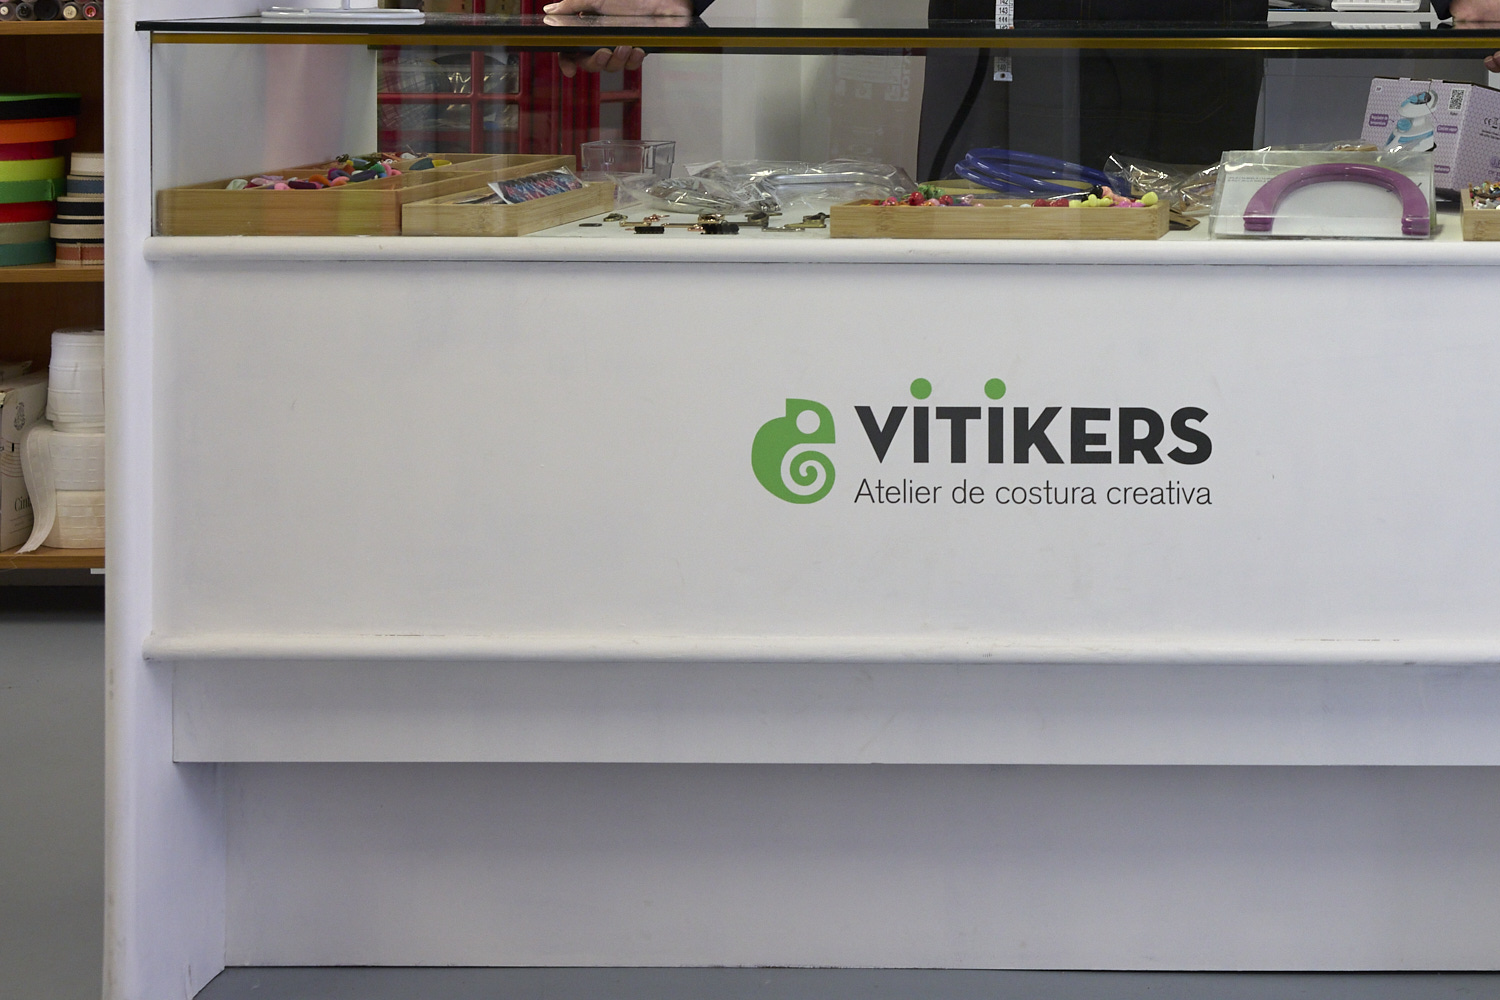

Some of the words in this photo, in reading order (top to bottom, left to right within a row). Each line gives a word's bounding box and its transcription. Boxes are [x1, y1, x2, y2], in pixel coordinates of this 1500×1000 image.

[854, 378, 1212, 465] VITIKERS
[854, 479, 942, 505] Atelier
[951, 479, 985, 505] de
[995, 481, 1096, 505] costura
[1106, 479, 1212, 505] creativa
